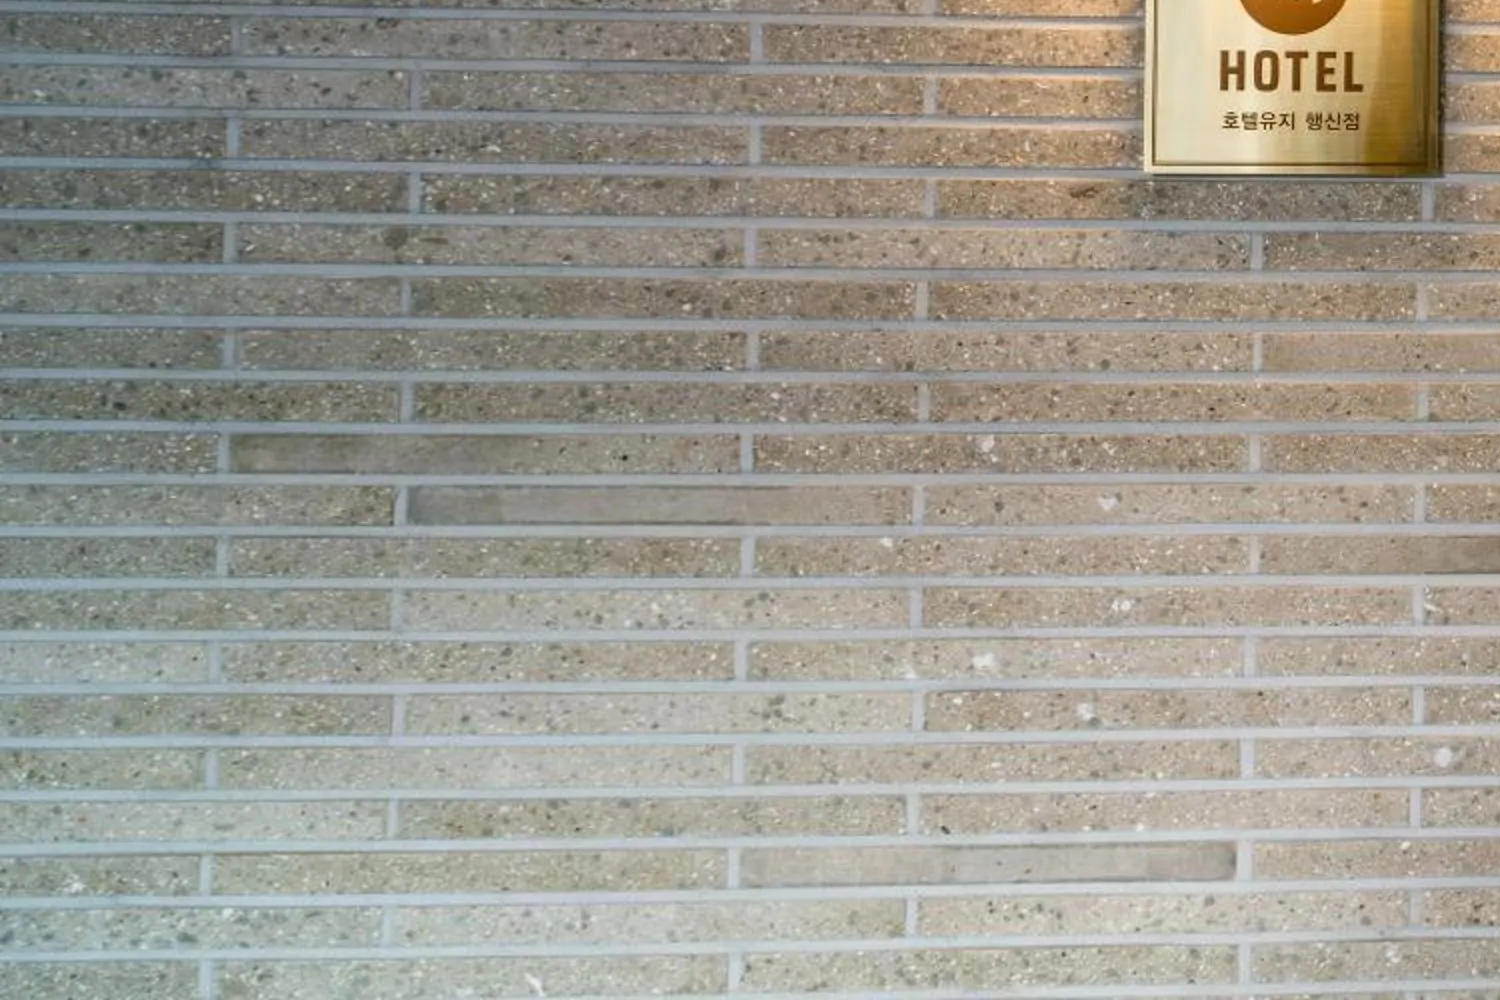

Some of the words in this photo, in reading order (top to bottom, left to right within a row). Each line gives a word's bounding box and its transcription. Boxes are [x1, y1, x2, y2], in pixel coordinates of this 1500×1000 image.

[1219, 50, 1364, 92] HOTEL
[1222, 111, 1295, 131] 호텔유지
[1305, 111, 1360, 131] 행신점
